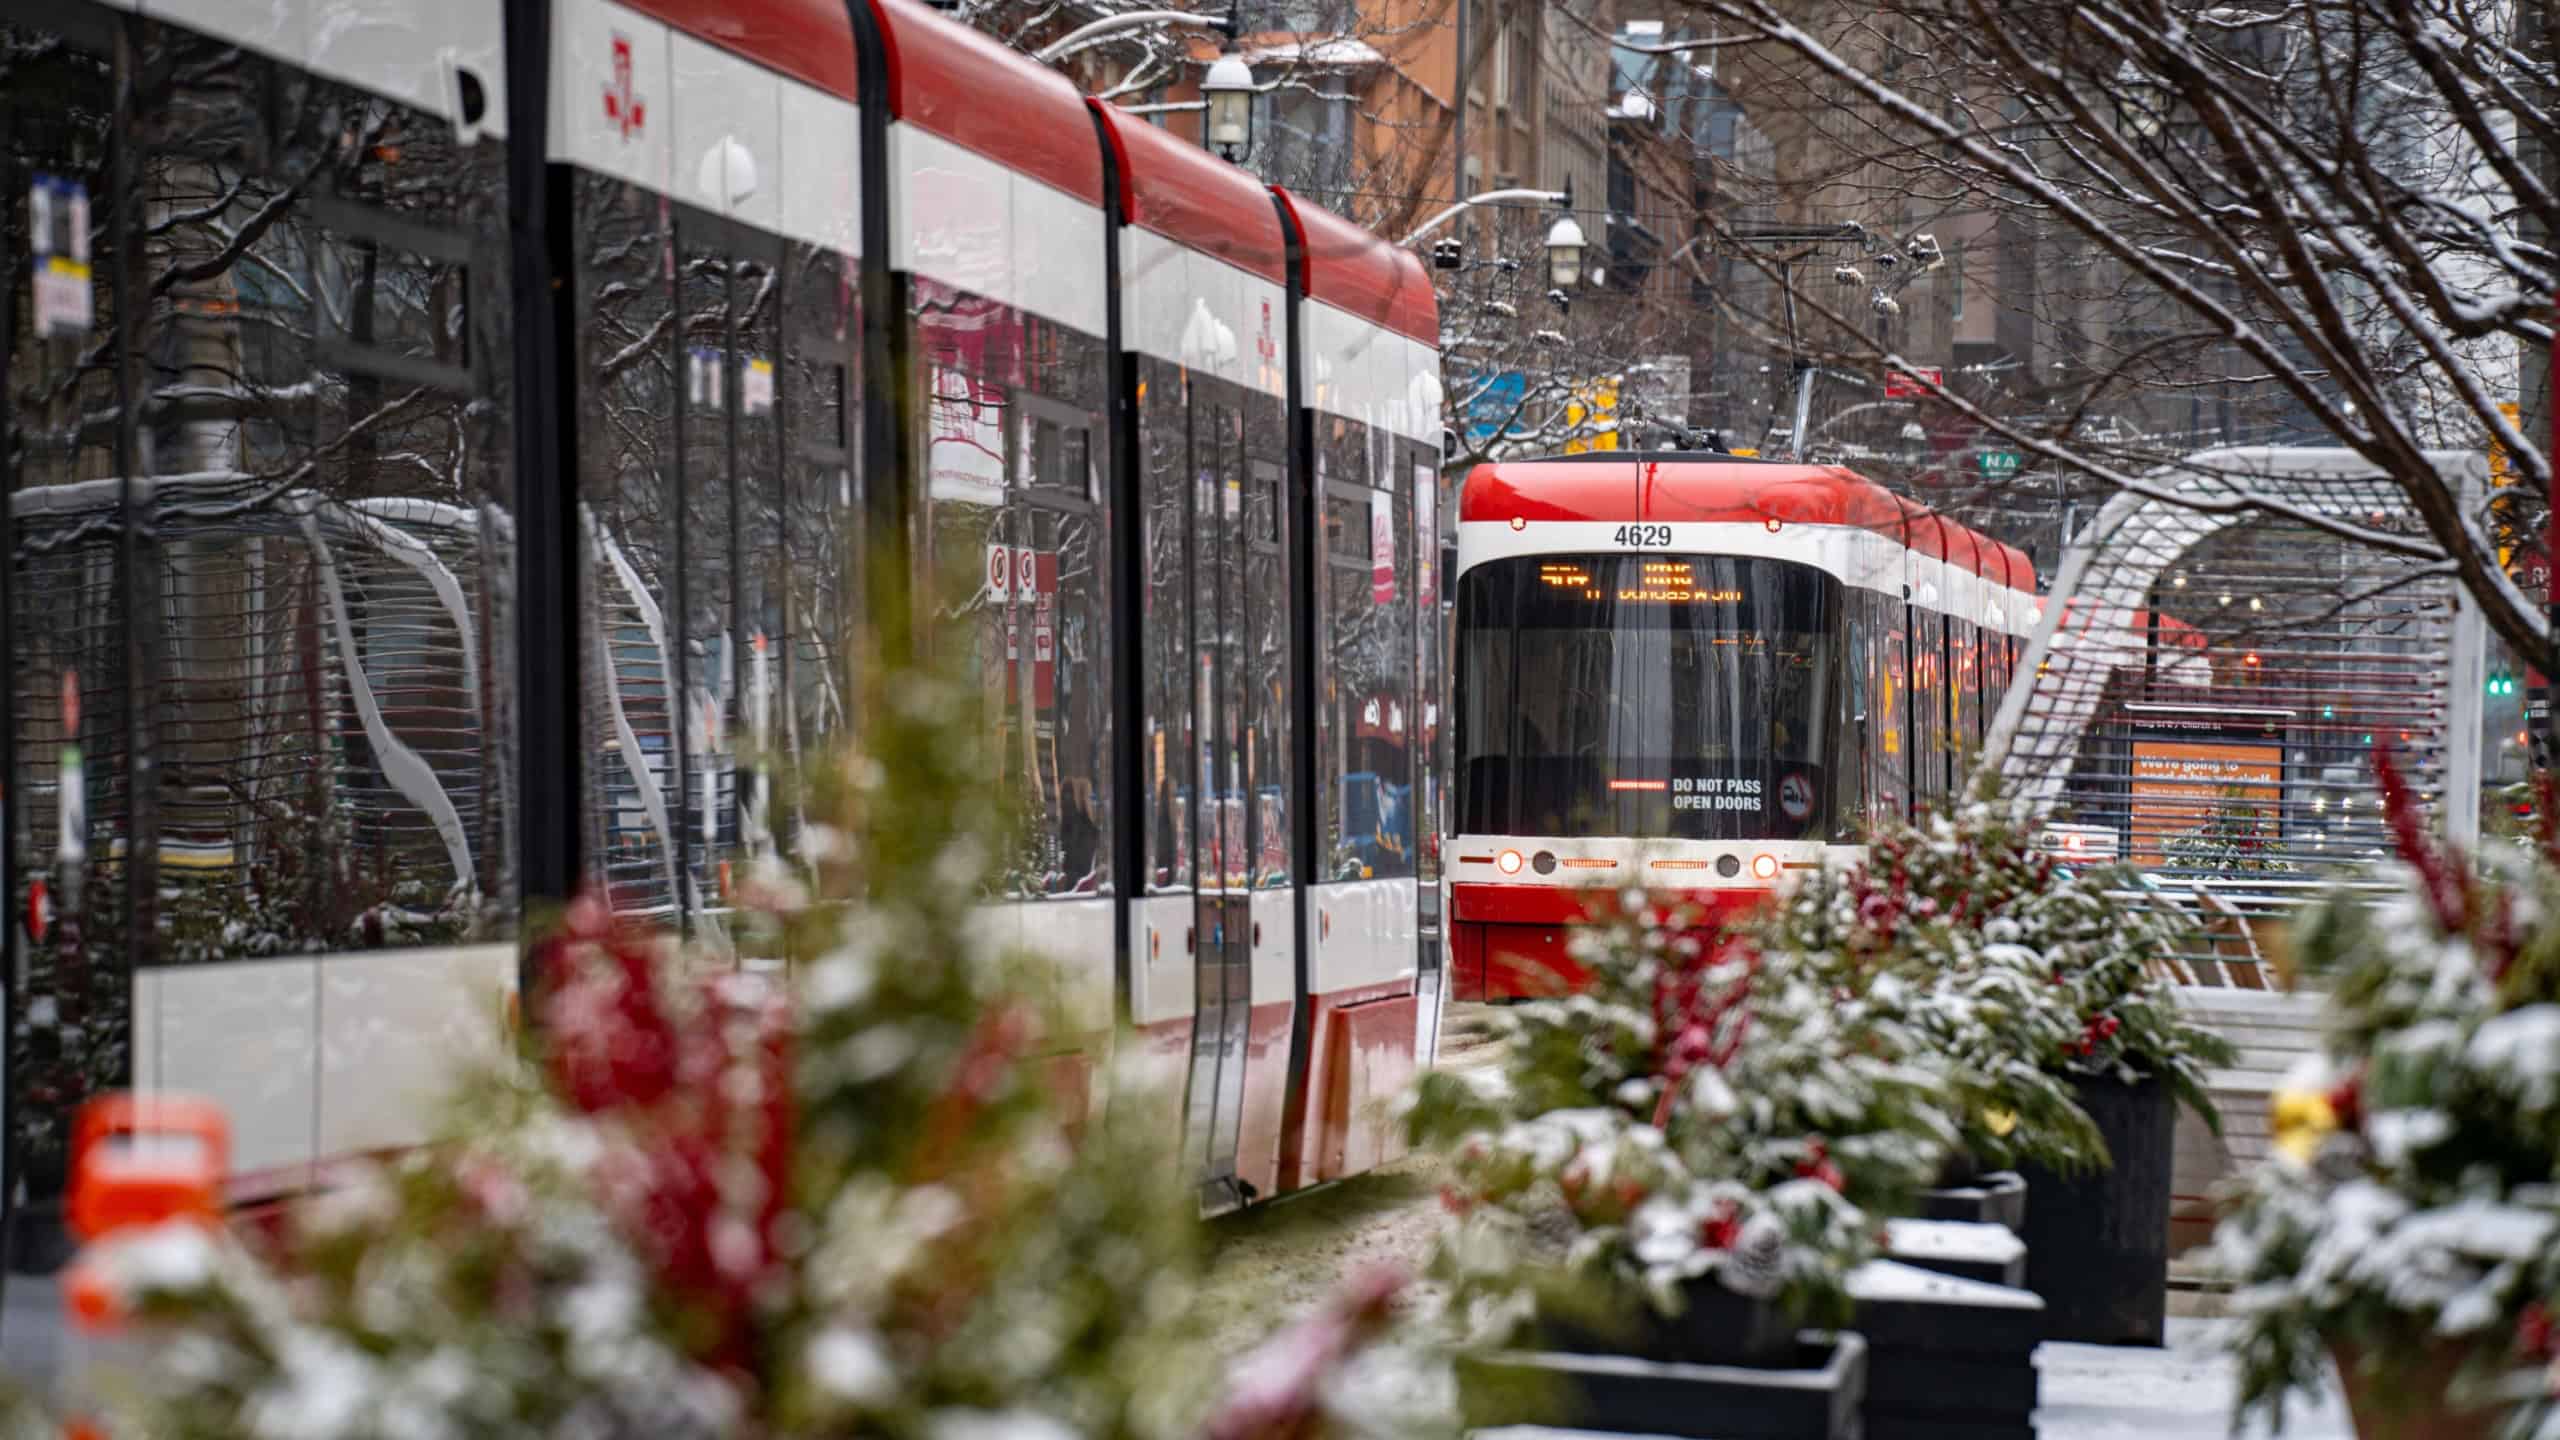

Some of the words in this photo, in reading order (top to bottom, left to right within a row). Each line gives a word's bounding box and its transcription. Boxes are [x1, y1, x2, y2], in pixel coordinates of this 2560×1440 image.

[1614, 525, 1672, 546] 4629
[2183, 758, 2220, 773] going
[1673, 778, 1692, 791] DO
[1697, 779, 1723, 792] NOT
[1727, 779, 1761, 793] PASS
[1674, 795, 1711, 809] OPEN
[1715, 796, 1761, 811] DOORS
